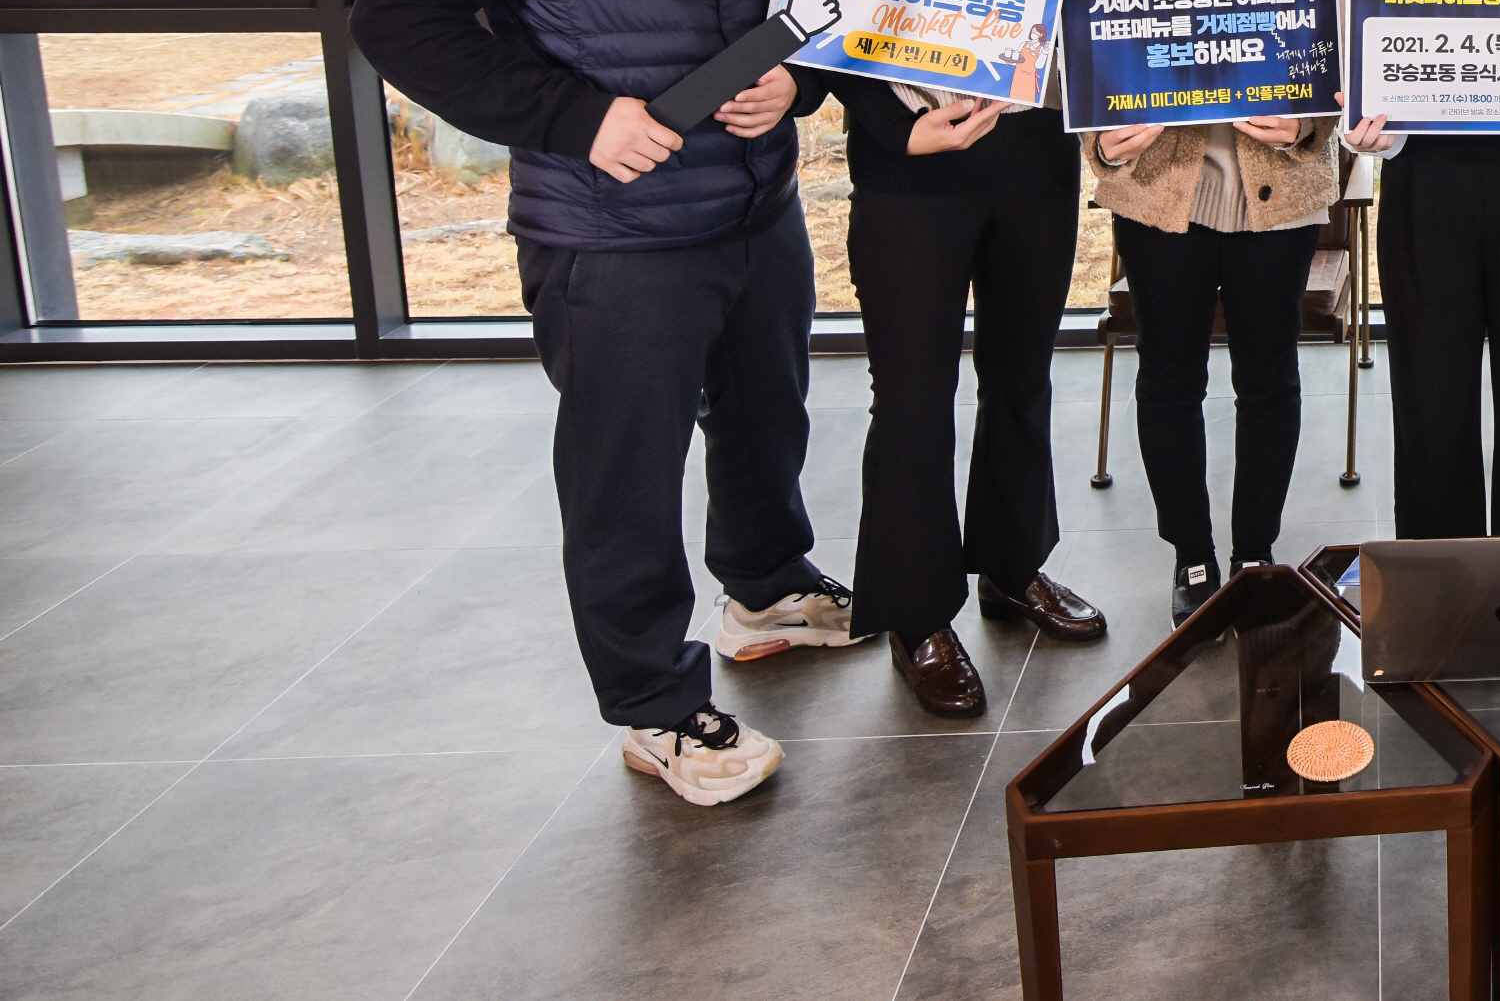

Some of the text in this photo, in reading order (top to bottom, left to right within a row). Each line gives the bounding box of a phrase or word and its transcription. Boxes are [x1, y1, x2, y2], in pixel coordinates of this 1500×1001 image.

[872, 4, 1023, 42] Market Live
[1090, 9, 1316, 41] 대표메뉴를 거제점빵에서
[854, 37, 968, 72] 제/작/발/표/회
[1147, 38, 1265, 68] 홍보하세요
[1276, 41, 1334, 61] 거제시 유튜브
[1381, 37, 1429, 53] 2021.
[1434, 34, 1454, 54] 2.
[1461, 34, 1480, 54] 4.
[1288, 58, 1328, 79] 공식채널
[1383, 63, 1456, 83] 장승포동
[1106, 93, 1147, 111] 거제시
[1151, 88, 1231, 108] 미디어홍보팀
[1246, 84, 1313, 103] 인플루언서
[1469, 94, 1492, 103] 18:00
